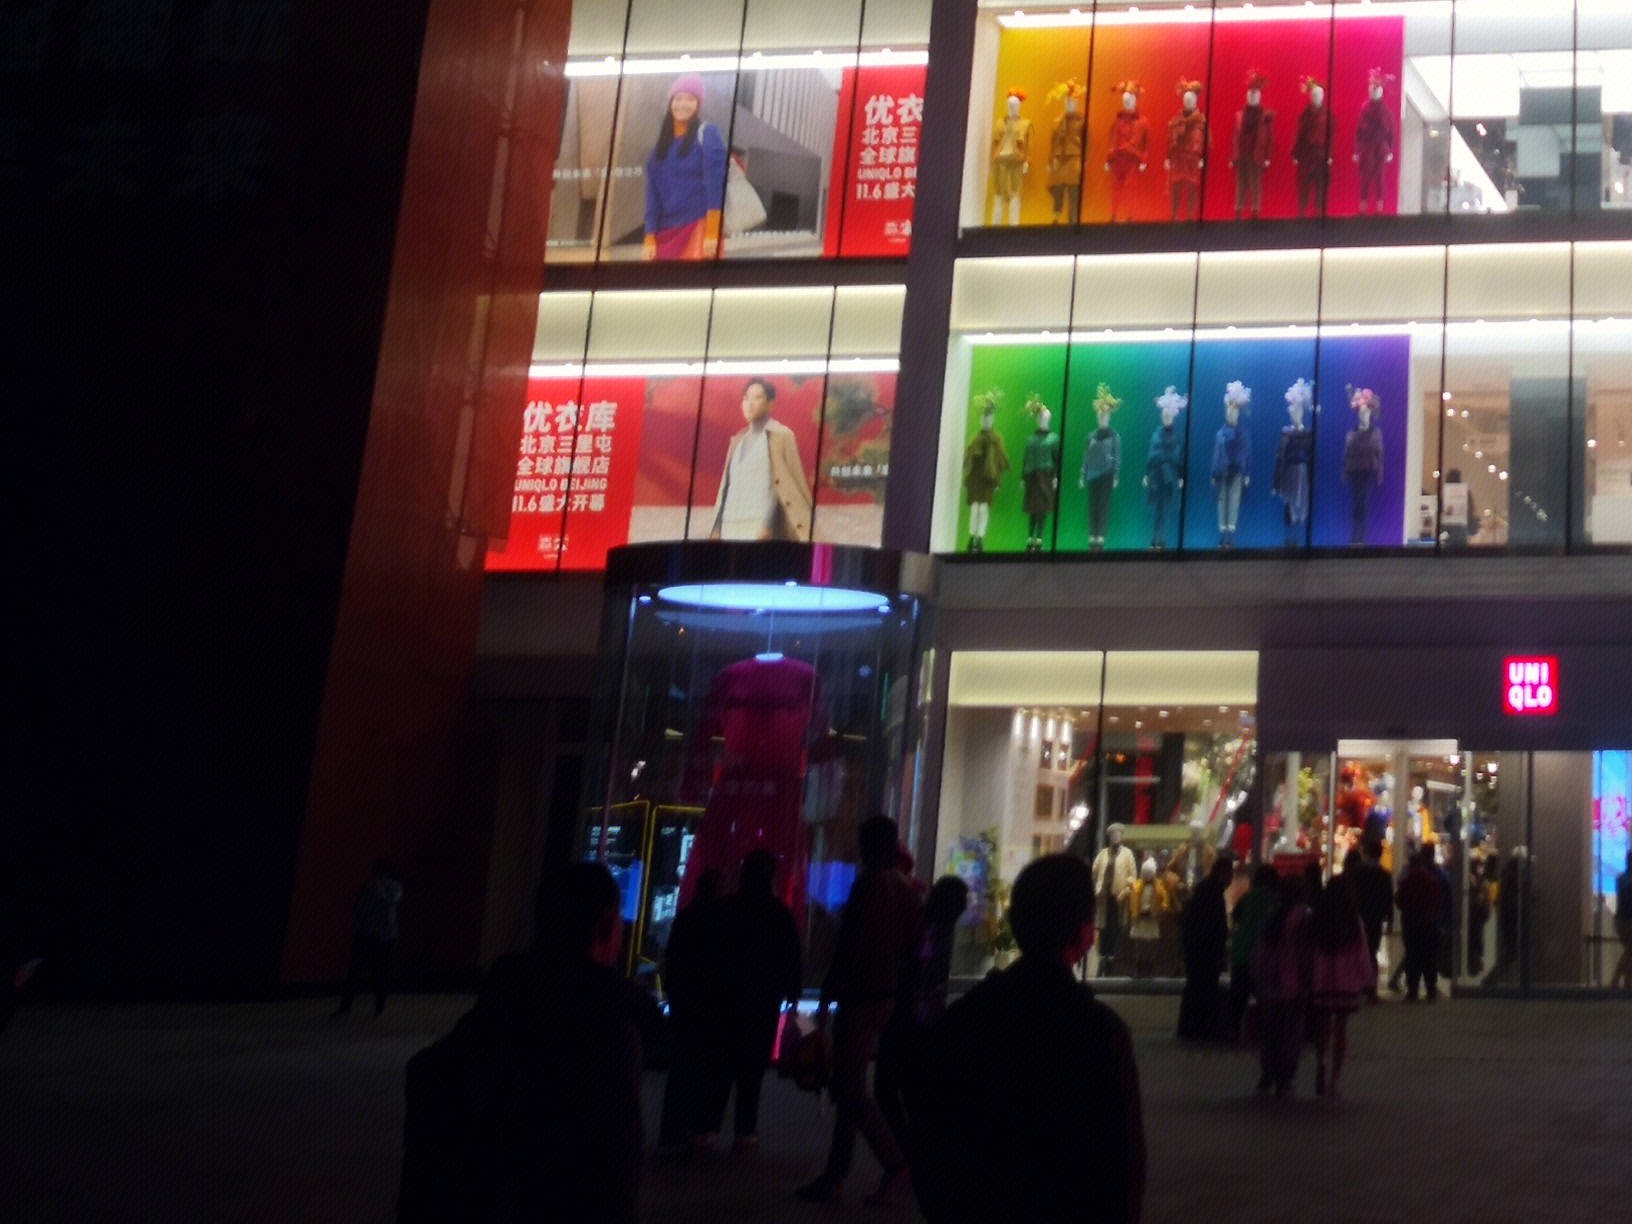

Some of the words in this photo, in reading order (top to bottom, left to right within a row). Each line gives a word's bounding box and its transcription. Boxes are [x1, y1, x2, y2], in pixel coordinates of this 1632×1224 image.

[523, 399, 618, 433] 优衣库
[519, 434, 612, 454] 北京三里屯
[516, 455, 610, 476] 全球旗舰店
[514, 478, 558, 493] UNIQLO
[559, 477, 608, 492] BEIJING
[1508, 662, 1550, 684] UNI
[1508, 684, 1553, 711] QLO
